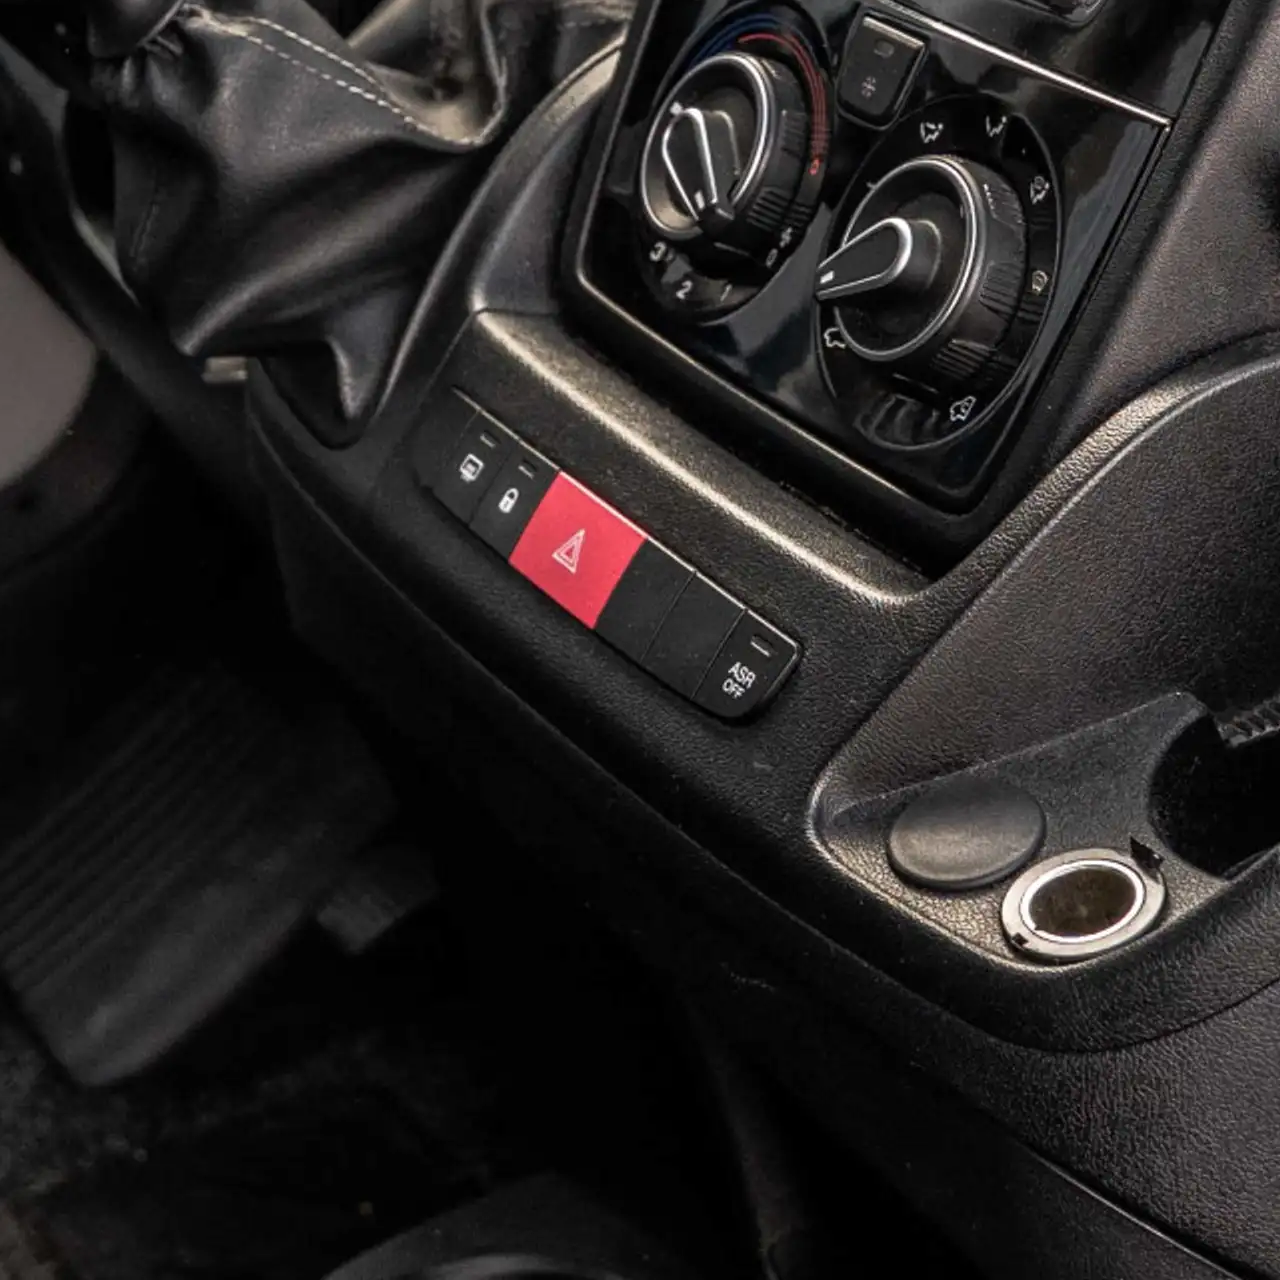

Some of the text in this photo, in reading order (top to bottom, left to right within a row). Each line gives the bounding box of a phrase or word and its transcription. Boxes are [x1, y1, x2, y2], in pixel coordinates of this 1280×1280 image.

[676, 280, 693, 300] 2
[728, 661, 756, 689] ASR
[722, 677, 746, 699] OFF
